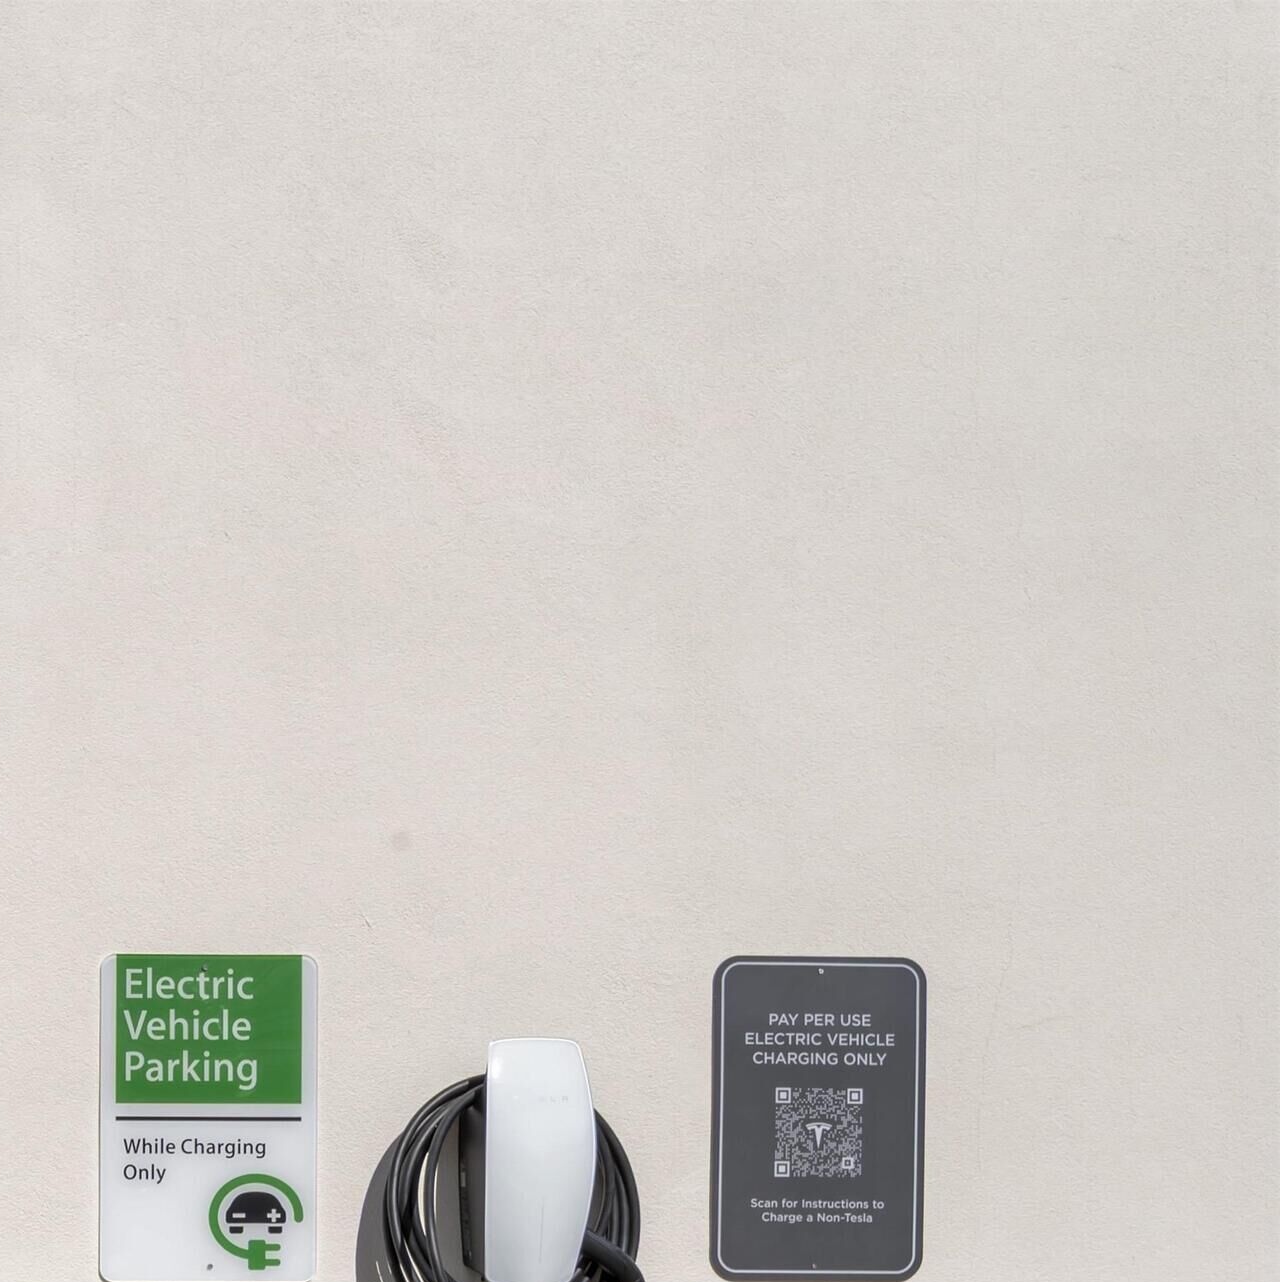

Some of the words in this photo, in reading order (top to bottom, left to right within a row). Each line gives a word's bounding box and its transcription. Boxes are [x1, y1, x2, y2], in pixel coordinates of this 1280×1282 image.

[125, 966, 254, 1001] Electric
[123, 1008, 252, 1041] Vehicle
[768, 1013, 799, 1026] PAY
[804, 1013, 835, 1027] PER
[840, 1013, 872, 1027] USE
[744, 1031, 822, 1046] ELECTRIC
[826, 1032, 895, 1047] VEHICLE
[752, 1051, 839, 1066] CHARGING
[843, 1052, 887, 1066] ONLY
[125, 1049, 258, 1091] Parking
[123, 1137, 176, 1155] While
[180, 1137, 266, 1159] Charging
[123, 1163, 167, 1185] Only
[750, 1197, 778, 1209] Scan
[781, 1197, 799, 1209] for
[801, 1199, 869, 1210] Instructions
[872, 1199, 885, 1210] to
[761, 1211, 803, 1224] Charge
[806, 1214, 814, 1223] a
[816, 1212, 873, 1223] Non-Tesla
